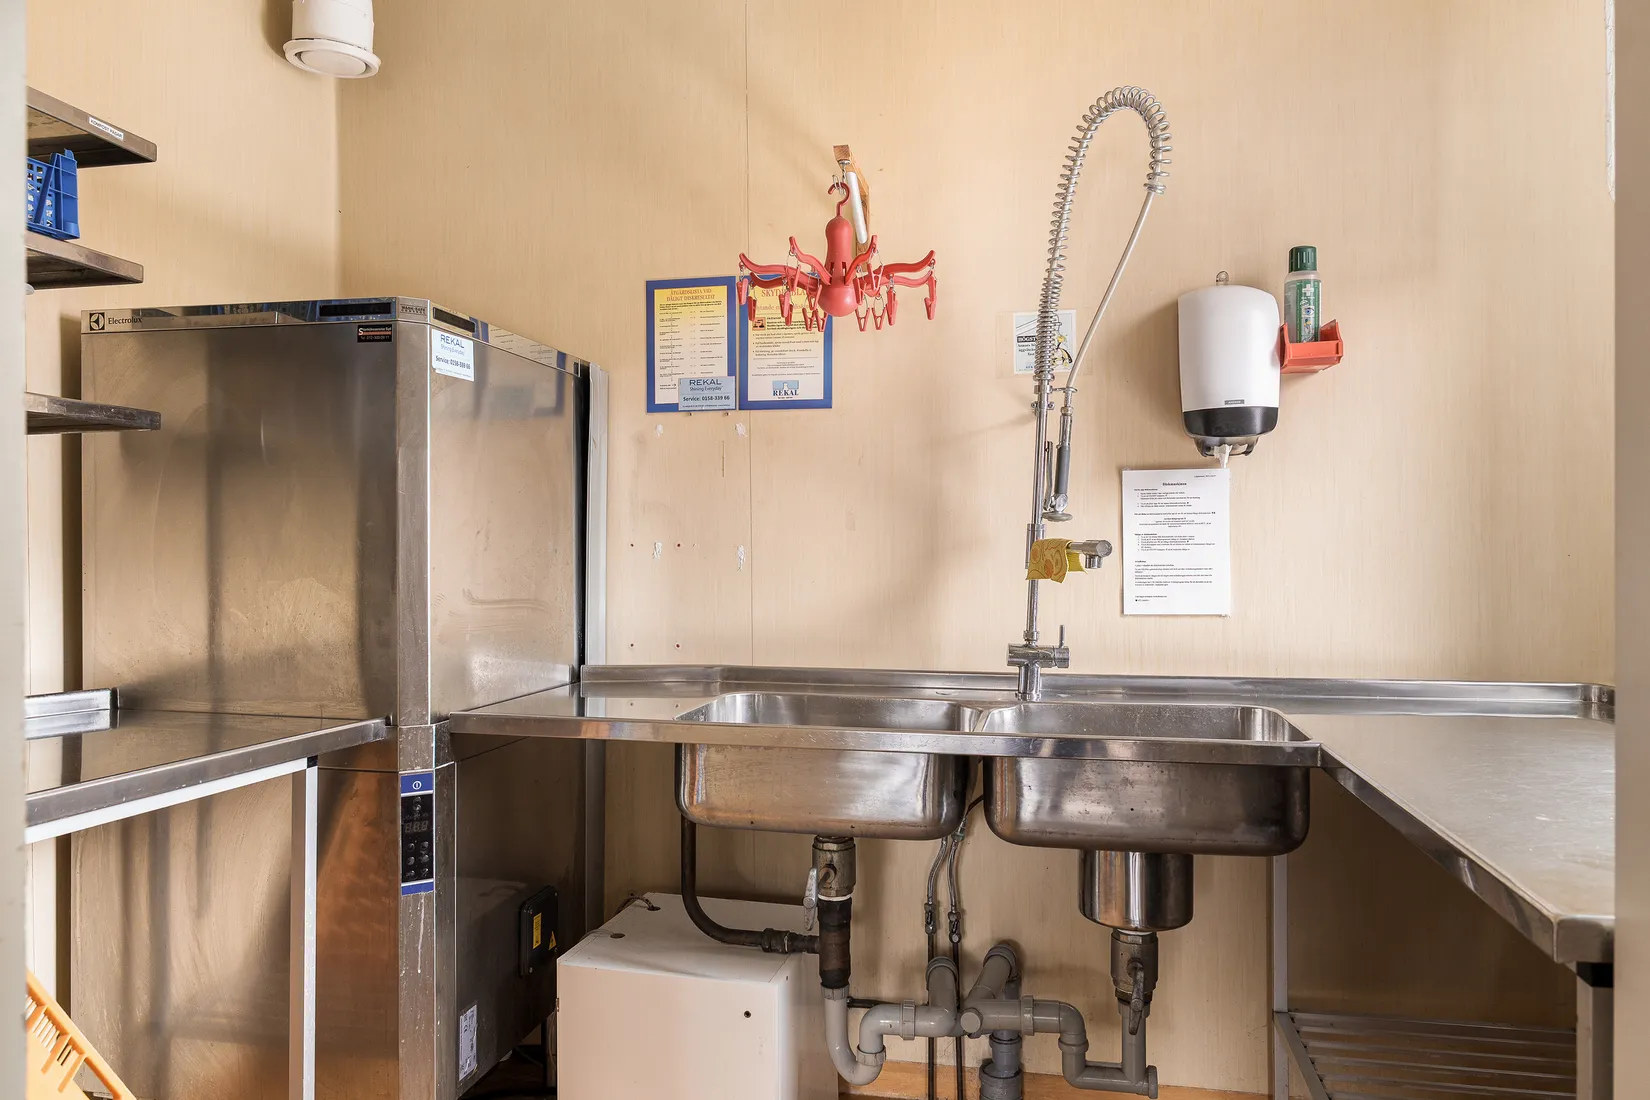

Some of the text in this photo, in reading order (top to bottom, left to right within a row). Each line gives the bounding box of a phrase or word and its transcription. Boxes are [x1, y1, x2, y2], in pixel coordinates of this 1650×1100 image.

[107, 317, 142, 325] Electrolux
[441, 334, 464, 348] REKAL
[772, 389, 800, 397] REKAL
